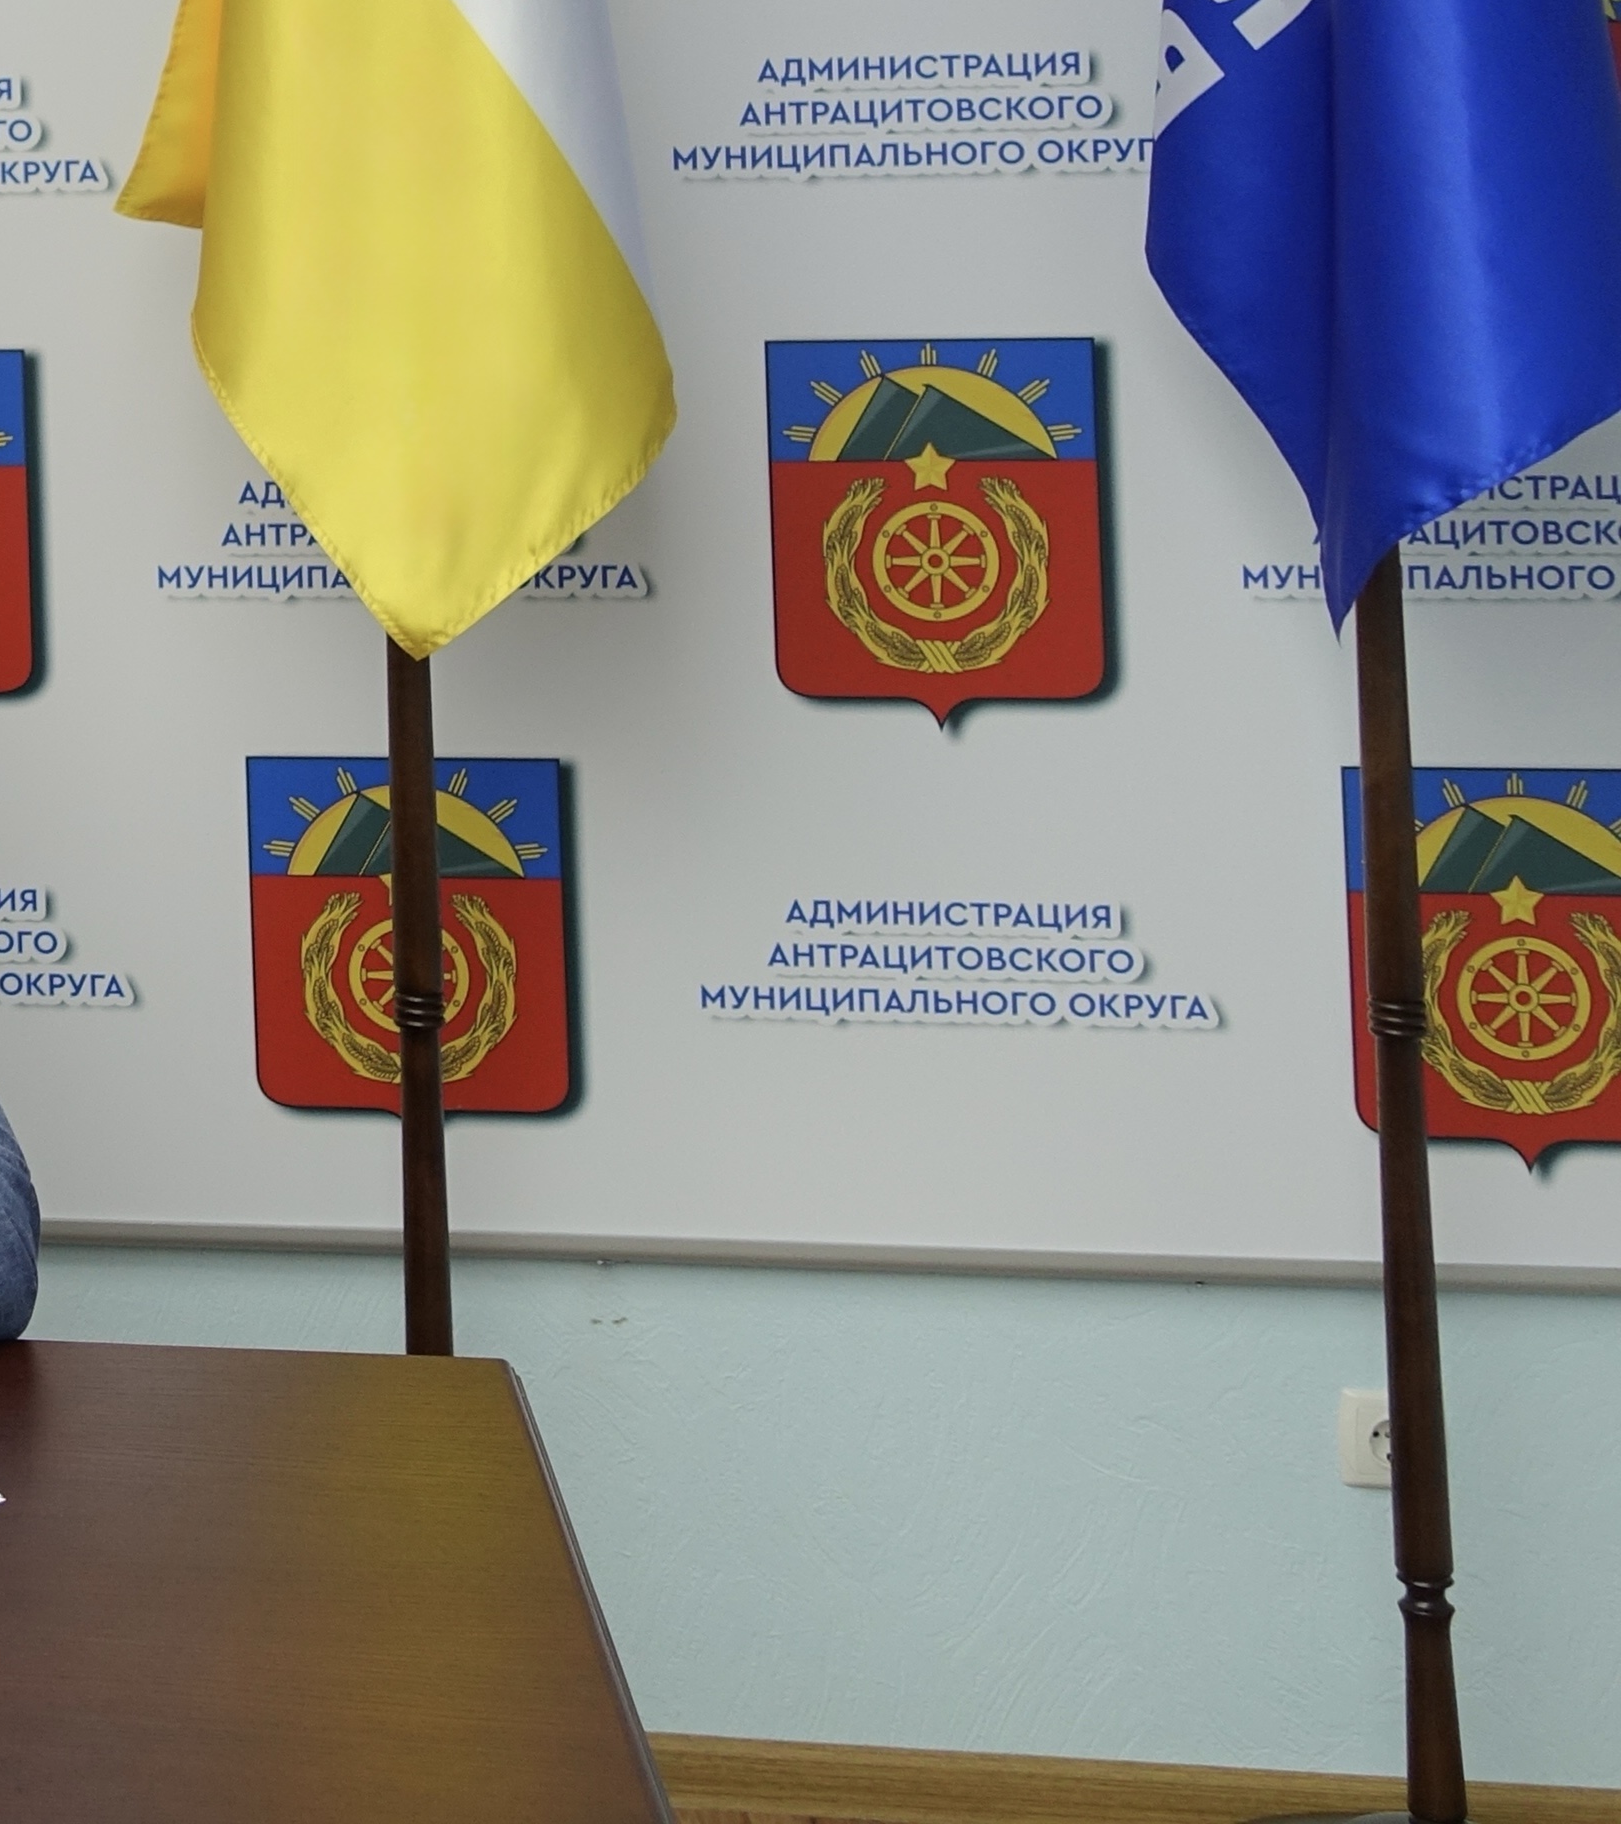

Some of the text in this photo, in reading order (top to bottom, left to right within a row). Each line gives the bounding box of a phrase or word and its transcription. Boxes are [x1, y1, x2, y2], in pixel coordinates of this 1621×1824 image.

[757, 52, 1082, 88] АДМИНИСТРАЦИЯ
[740, 94, 1103, 128] АНТРАЦИТОВСКОГО
[672, 137, 1154, 173] МУНИЦИПАЛЬНОГО ОКРУГ
[157, 564, 639, 593] МУНИЦИПА КРУГА
[1242, 564, 1616, 591] МУНПАЛЬНОГО
[785, 898, 1113, 933] АДМИНИСТРАЦИЯ
[767, 942, 1135, 976] АНТРАЦИТОВСКОГО
[700, 984, 1210, 1020] МУНИЦИПАЛЬНОГО ОКРУГА
